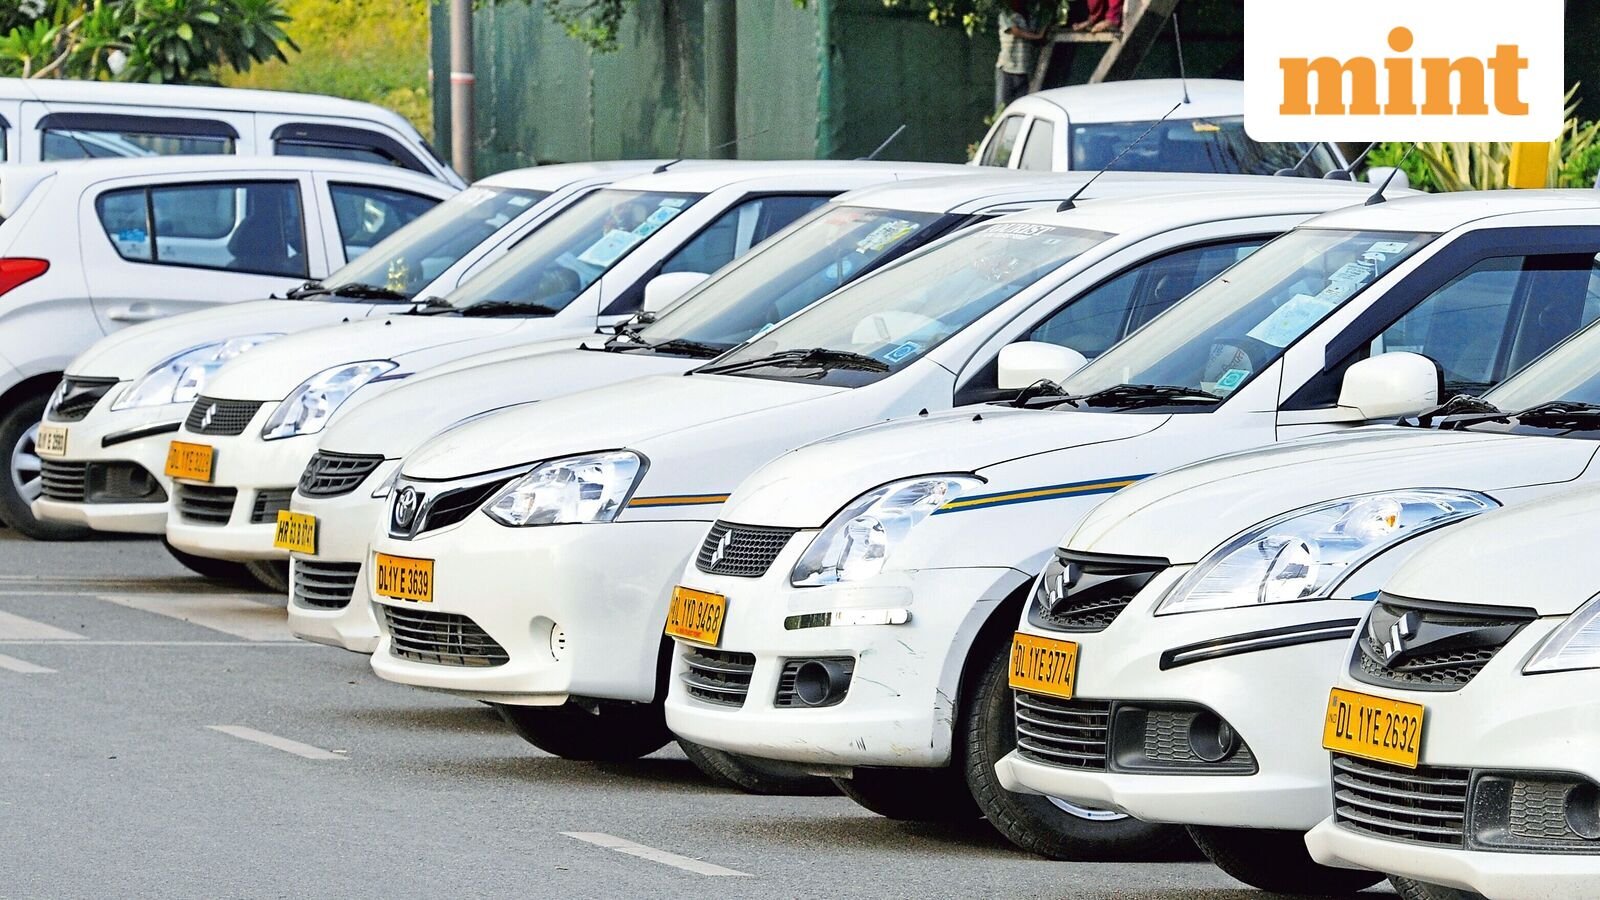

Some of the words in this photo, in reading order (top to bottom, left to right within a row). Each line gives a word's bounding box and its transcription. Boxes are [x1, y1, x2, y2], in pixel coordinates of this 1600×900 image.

[278, 520, 289, 543] HR
[408, 568, 428, 596] 3639
[1015, 645, 1025, 677] DL
[1028, 647, 1047, 682] 1YE
[1046, 650, 1073, 687] 3774
[1336, 702, 1352, 740] DL
[1358, 706, 1382, 745] 1YE
[1383, 712, 1417, 753] 2632
